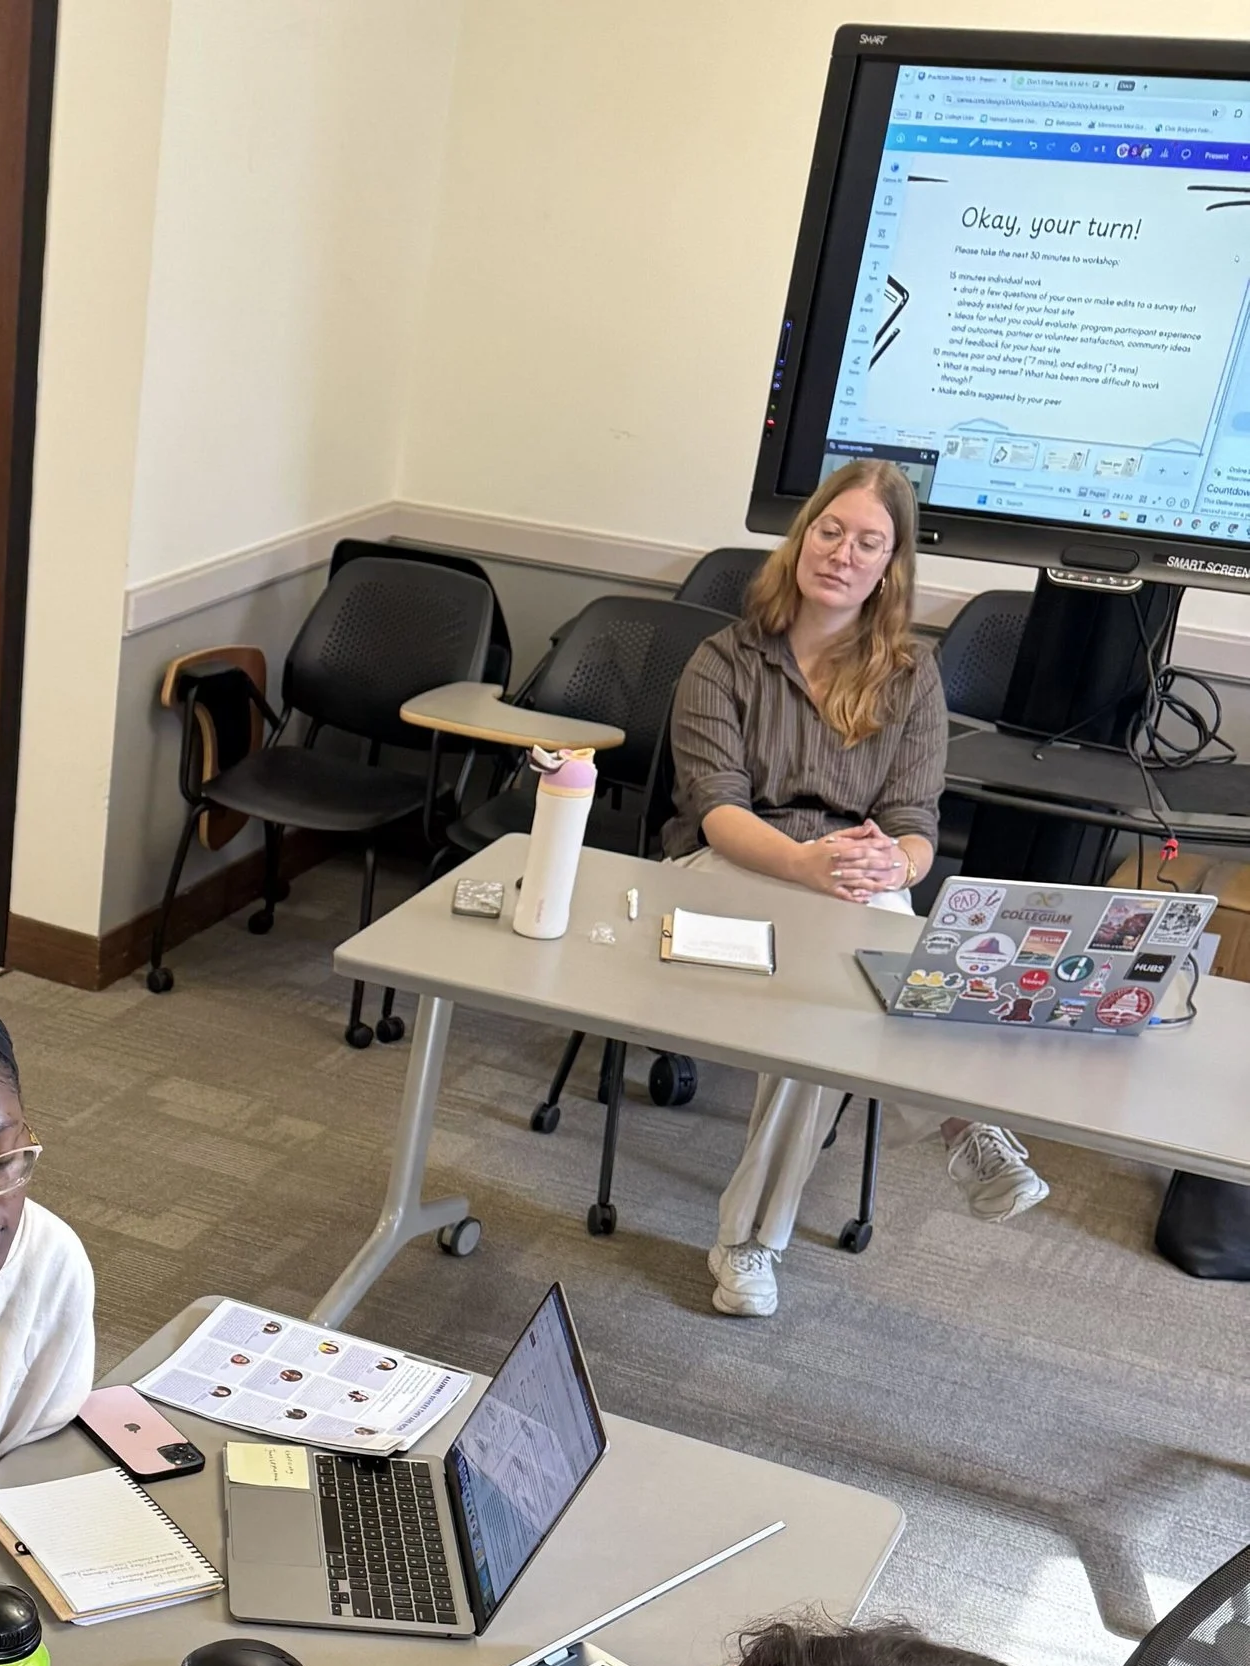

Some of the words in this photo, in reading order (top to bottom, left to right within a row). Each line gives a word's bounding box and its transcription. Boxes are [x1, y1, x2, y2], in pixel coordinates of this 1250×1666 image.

[859, 33, 888, 45] SMART
[962, 207, 1020, 237] Okay,
[1030, 218, 1080, 239] your
[1088, 218, 1141, 240] turn!
[955, 246, 978, 255] Please
[981, 248, 996, 256] take
[999, 249, 1010, 257] the
[1042, 254, 1070, 262] minutes
[1083, 257, 1120, 267] workshop:
[958, 274, 986, 282] minutes
[988, 275, 1023, 285] individual
[957, 299, 984, 310] already
[1014, 303, 1025, 311] for
[1044, 306, 1060, 314] host
[960, 286, 978, 294] draft
[987, 287, 1001, 296] few
[1003, 291, 1037, 299] questions
[1039, 292, 1048, 300] of
[1094, 297, 1114, 305] make
[1117, 299, 1135, 307] edits
[1154, 304, 1178, 313] survey
[1181, 304, 1196, 312] that
[955, 312, 974, 320] Ideas
[976, 312, 986, 321] for
[988, 314, 1006, 323] what
[1023, 318, 1043, 326] could
[1081, 324, 1113, 333] program
[1114, 328, 1157, 336] participant
[1159, 332, 1201, 340] experience
[949, 337, 963, 345] and
[965, 338, 998, 348] feedback
[1001, 341, 1011, 349] for
[1012, 344, 1028, 352] your
[1030, 344, 1046, 352] host
[1045, 333, 1078, 342] volunteer
[1128, 341, 1168, 352] community
[1170, 344, 1190, 352] ideas
[986, 353, 1001, 361] and
[1003, 354, 1022, 363] share
[1077, 362, 1102, 373] editing
[941, 374, 973, 385] through?
[944, 362, 962, 370] What
[971, 365, 996, 376] making
[998, 368, 1023, 376] sense?
[1025, 370, 1043, 378] What
[1045, 372, 1058, 380] has
[1060, 373, 1079, 381] been
[1102, 377, 1130, 386] difficult
[938, 387, 957, 395] Make
[959, 389, 976, 397] edits
[978, 392, 1015, 401] suggested
[1017, 394, 1026, 404] by
[1166, 554, 1205, 571] SMART
[1001, 909, 1073, 925] COLLEGIUM
[1134, 962, 1165, 974] HUBS
